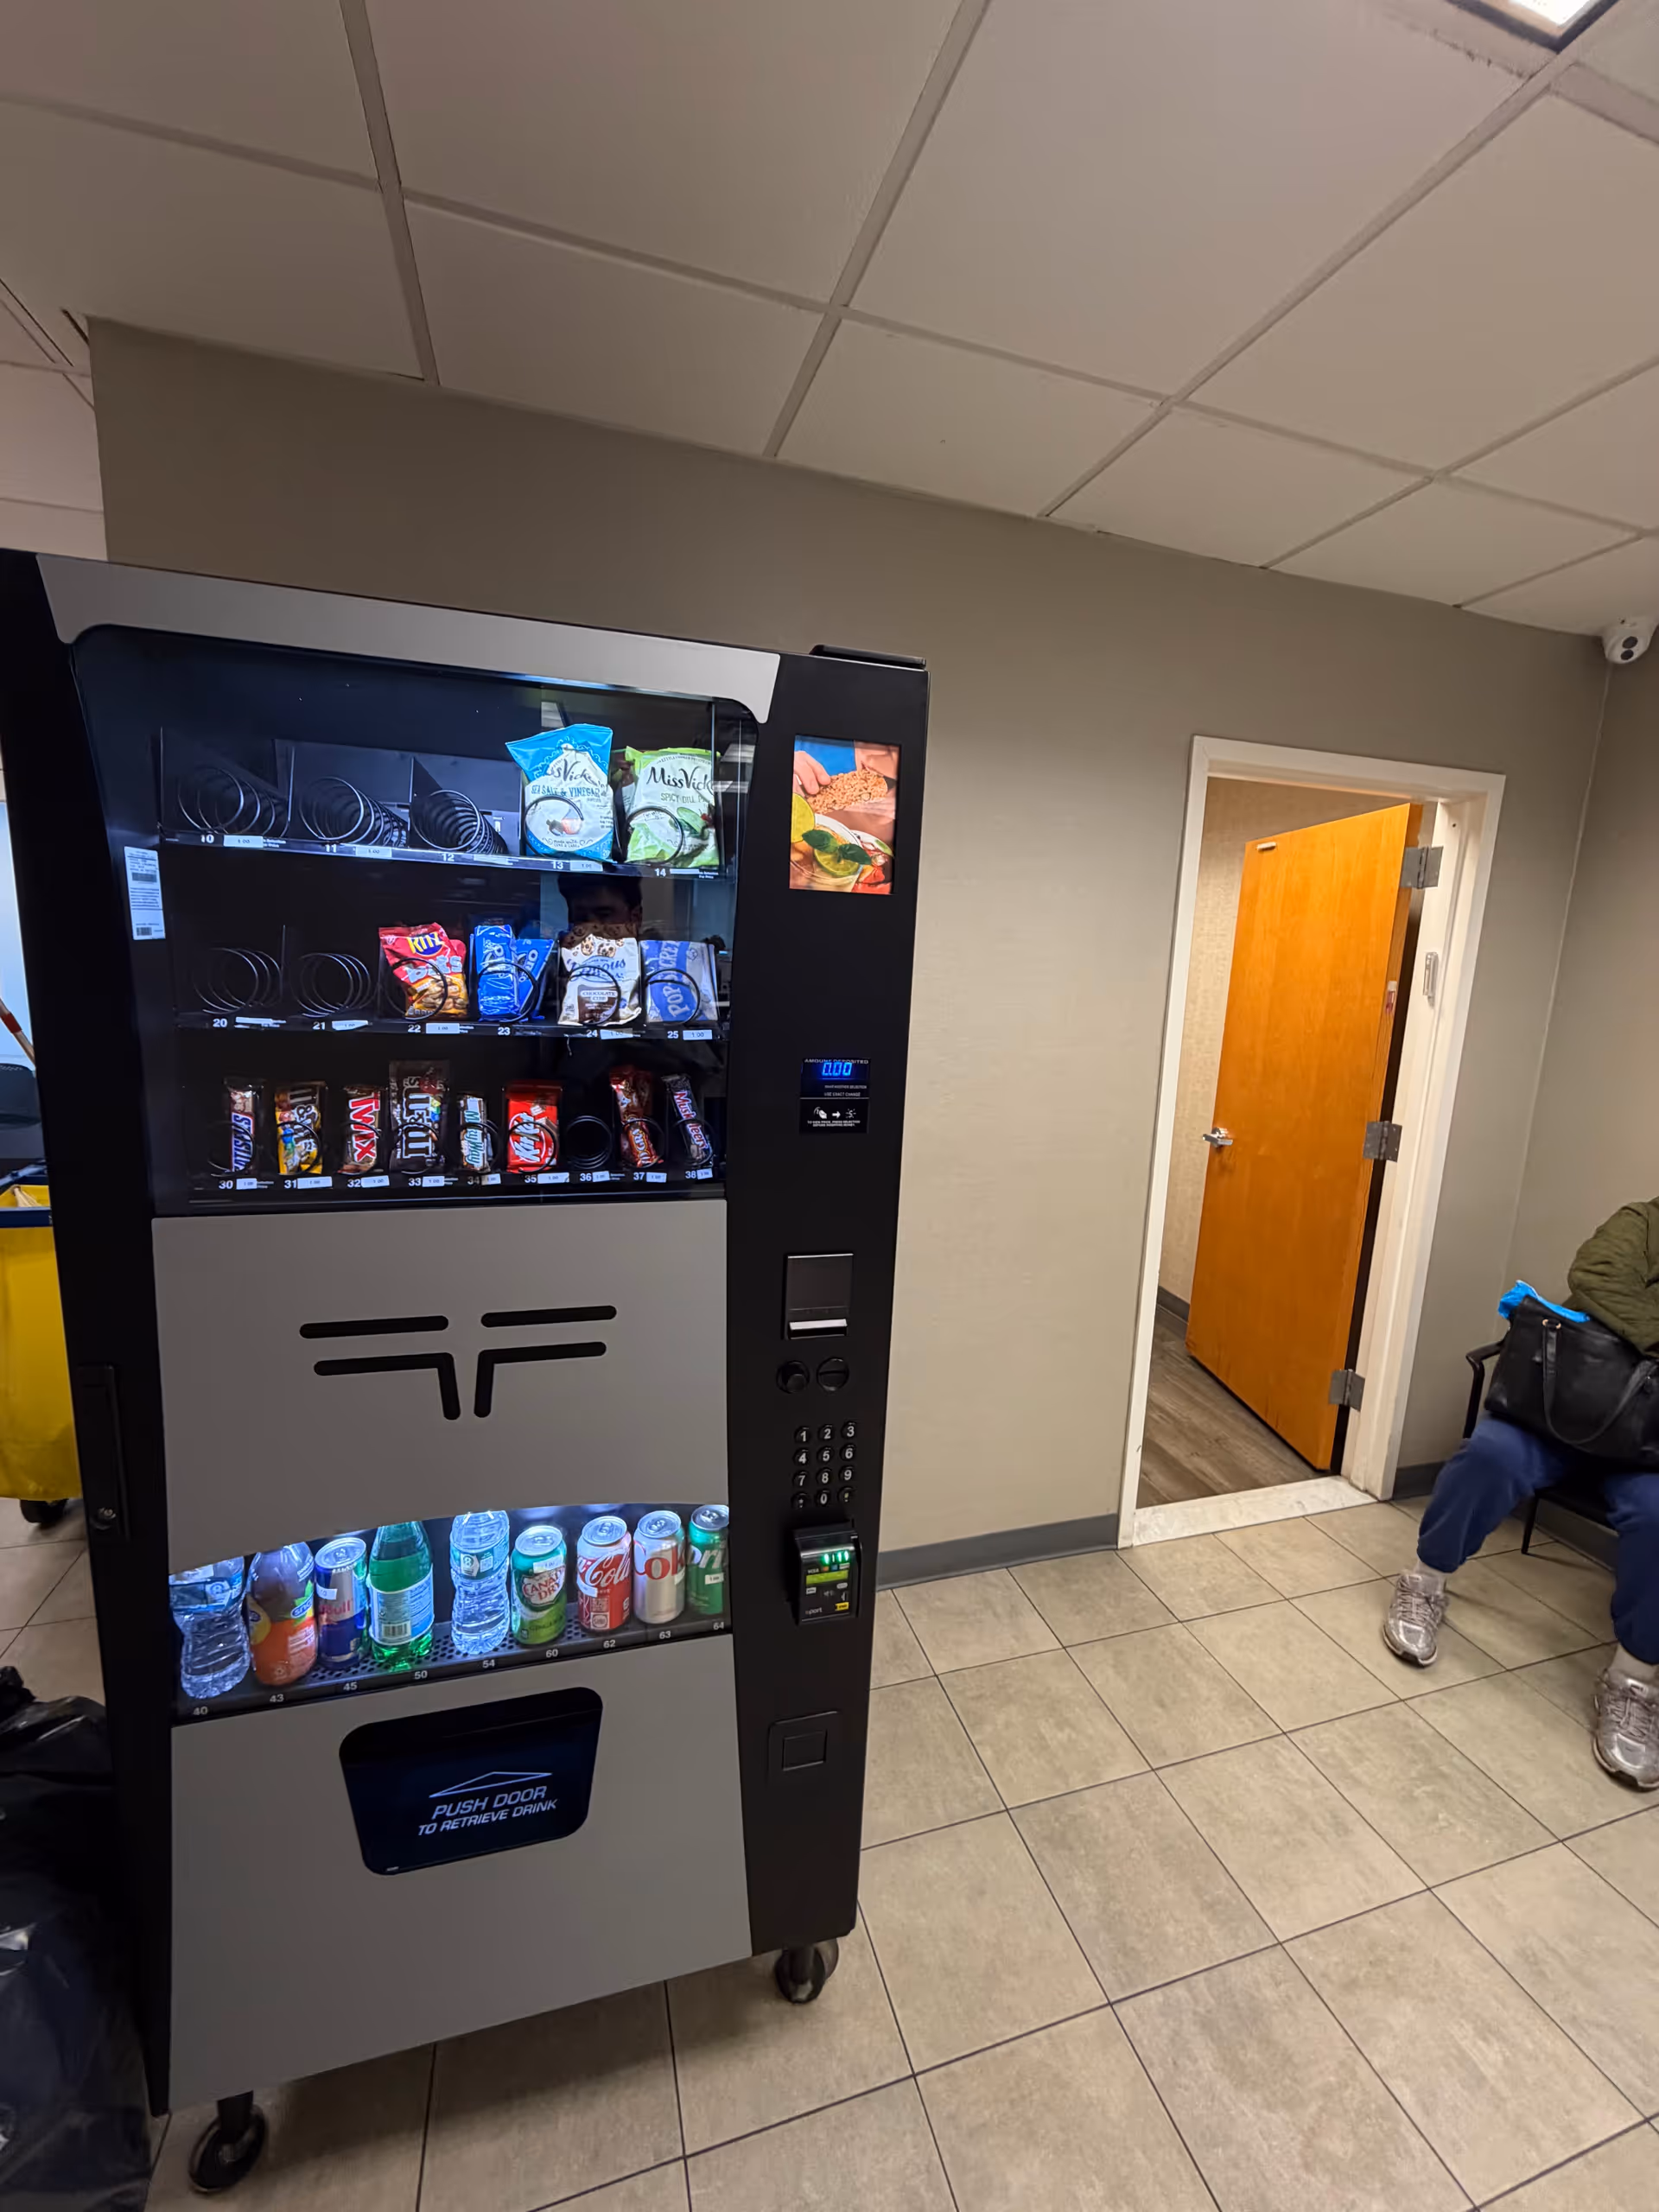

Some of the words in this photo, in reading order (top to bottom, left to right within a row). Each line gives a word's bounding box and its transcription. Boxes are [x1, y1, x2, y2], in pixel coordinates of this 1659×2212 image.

[542, 785, 558, 796] SALT
[560, 787, 567, 797] &
[569, 786, 601, 798] VINEGAR
[660, 792, 680, 803] SPICY
[682, 794, 695, 804] DILL
[200, 834, 214, 843] 10
[325, 844, 337, 853] 11
[442, 853, 454, 861] 12
[551, 861, 563, 869] 13
[655, 868, 666, 877] 14
[407, 931, 446, 954] RITZ
[662, 985, 690, 1017] POP
[213, 1019, 227, 1027] 20
[313, 1021, 326, 1030] 21
[498, 1027, 511, 1036] 23
[587, 1029, 598, 1038] 24
[667, 1030, 678, 1039] 25
[822, 1061, 853, 1077] 0.00
[674, 1090, 709, 1149] Muskteers
[348, 1092, 380, 1163] TWIX
[466, 1141, 484, 1166] Way
[580, 1173, 592, 1182] 36
[633, 1172, 645, 1180] 37
[685, 1170, 696, 1179] 38
[219, 1179, 233, 1189] 30
[284, 1179, 296, 1188] 31
[347, 1179, 361, 1188] 32
[408, 1177, 422, 1186] 33
[467, 1176, 480, 1185] 34
[524, 1175, 537, 1184] 35
[800, 1431, 807, 1442] 1
[823, 1428, 831, 1440] 2
[847, 1426, 855, 1437] 3
[798, 1452, 807, 1464] 4
[823, 1451, 830, 1462] 5
[845, 1448, 853, 1459] 6
[798, 1475, 806, 1486] 7
[822, 1472, 830, 1484] 8
[843, 1470, 852, 1480] 9
[820, 1493, 828, 1504] 0
[659, 1630, 671, 1639] 63
[603, 1639, 616, 1649] 62
[546, 1649, 558, 1657] 60
[482, 1659, 495, 1668] 54
[414, 1670, 428, 1680] 50
[343, 1681, 358, 1691] 45
[270, 1694, 283, 1703] 43
[193, 1706, 208, 1716] 40
[431, 1797, 488, 1820] PUSH
[493, 1786, 547, 1808] DOOR
[417, 1823, 436, 1836] TO
[440, 1809, 509, 1832] RETRIEVE
[512, 1799, 558, 1817] DRINK
